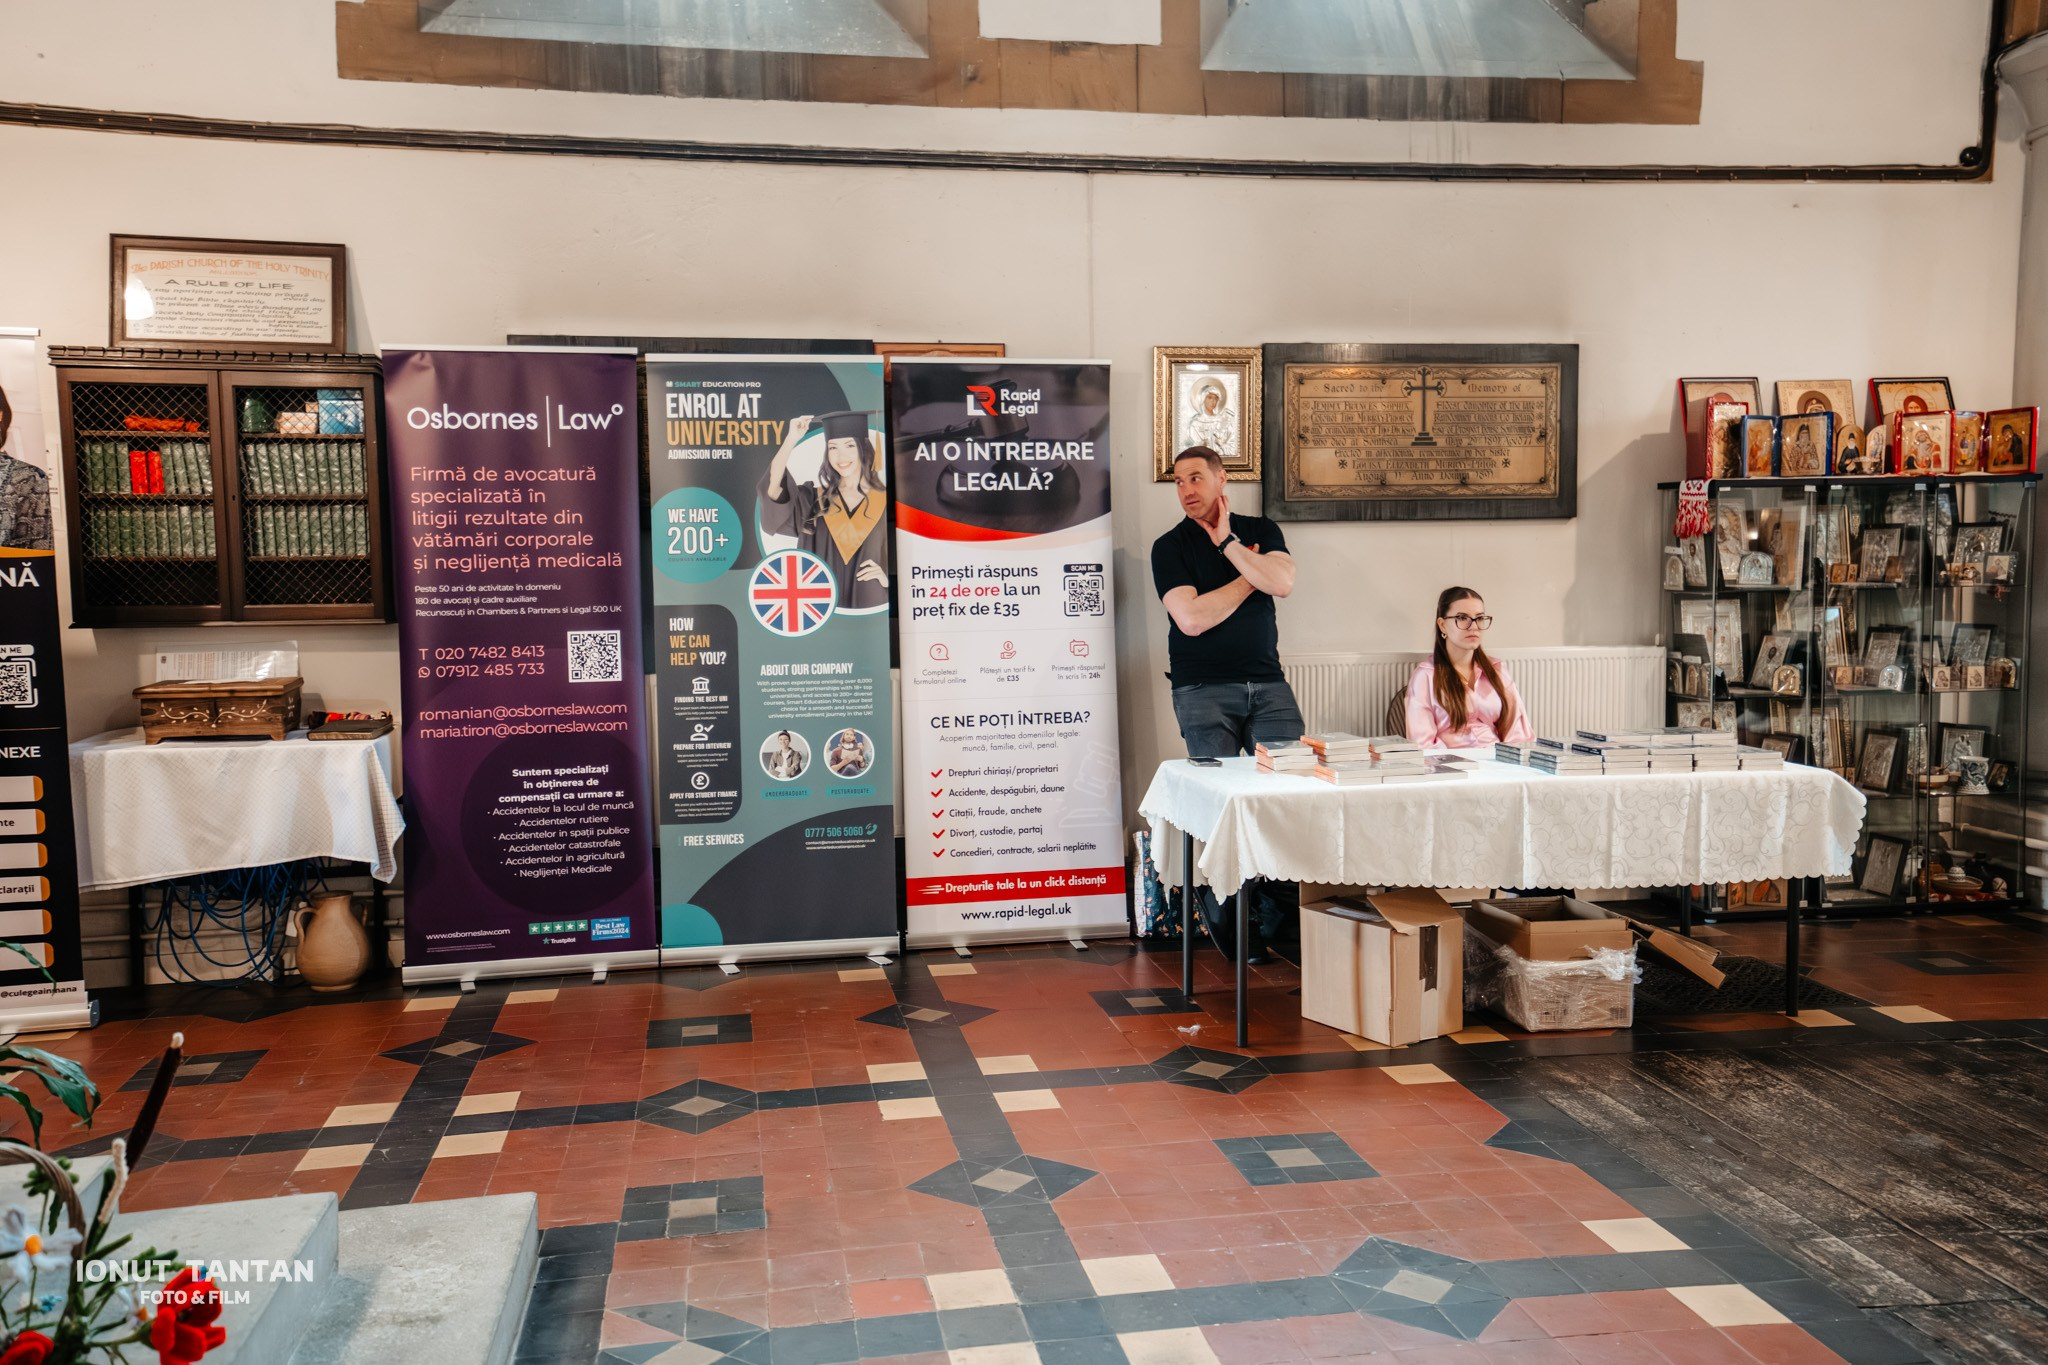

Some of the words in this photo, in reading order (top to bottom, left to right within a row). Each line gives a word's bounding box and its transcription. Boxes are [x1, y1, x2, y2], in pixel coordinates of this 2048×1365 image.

[187, 259, 227, 268] CHURCH
[229, 259, 243, 268] OF
[245, 259, 262, 269] THE
[265, 263, 291, 273] HOLY
[294, 265, 330, 280] TRINITY
[1001, 389, 1040, 403] Rapid
[666, 393, 731, 418] ENROL
[737, 393, 761, 418] AT
[1001, 403, 1038, 417] Legal
[407, 403, 538, 430] Osbornes
[666, 421, 785, 446] UNIVERSITY
[668, 449, 710, 460] ADMISSION
[712, 449, 732, 460] OPEN
[914, 443, 937, 461] AI
[943, 443, 961, 461] O
[966, 438, 1094, 460] ÎNTREBARE
[411, 466, 466, 481] Firmă
[473, 467, 497, 481] de
[504, 466, 596, 481] avocatură
[954, 468, 1053, 491] LEGALĂ?
[411, 488, 522, 507] specializată
[529, 488, 546, 503] în
[412, 511, 457, 529] litigii
[464, 511, 548, 526] rezultate
[554, 510, 583, 524] din
[668, 509, 685, 523] WE
[689, 508, 718, 523] HAVE
[412, 532, 498, 548] vătămări
[504, 532, 594, 550] corporale
[667, 527, 729, 555] 200+
[413, 555, 427, 574] și
[435, 554, 530, 572] neglijență
[537, 552, 622, 568] medicală
[912, 565, 974, 582] Primești
[978, 566, 1038, 580] răspuns
[414, 585, 437, 593] Peste
[466, 584, 476, 592] de
[478, 584, 514, 592] activitate
[525, 583, 561, 591] domeniu
[911, 585, 926, 598] în
[929, 586, 947, 600] 24
[951, 584, 971, 596] de
[975, 587, 1000, 596] ore
[1003, 583, 1019, 596] la
[1022, 586, 1040, 595] un
[912, 603, 944, 621] preț
[949, 603, 965, 616] fix
[970, 602, 990, 615] de
[994, 602, 1020, 617] £35
[669, 618, 694, 631] HOW
[670, 636, 686, 648] WE
[689, 635, 710, 647] CAN
[419, 648, 429, 660] T
[435, 648, 464, 660] 020
[469, 646, 507, 659] 7482
[511, 645, 545, 658] 8413
[670, 652, 697, 666] HELP
[699, 652, 727, 665] YOU?
[436, 665, 479, 678] 07912
[484, 664, 514, 676] 485
[518, 663, 545, 675] 733
[760, 664, 789, 676] ABOUT
[791, 664, 809, 675] OUR
[811, 663, 853, 674] COMPANY
[419, 702, 627, 721] romanian@osborneslaw.com
[931, 716, 950, 728] CE
[955, 716, 975, 727] NE
[980, 714, 1013, 728] POȚI
[1018, 710, 1090, 726] ÎNTREBA?
[420, 720, 628, 739] maria.tiron@osborneslaw.com
[512, 768, 552, 777] Suntem
[554, 765, 609, 776] specializați
[949, 768, 981, 778] Drepturi
[536, 779, 584, 789] obținerea
[586, 778, 599, 786] de
[949, 788, 988, 797] Accidente,
[1041, 784, 1065, 793] daune
[499, 792, 560, 803] compensații
[563, 792, 575, 800] ca
[577, 791, 613, 799] urmare
[615, 790, 624, 798] a:
[493, 805, 550, 815] Accidentelor
[553, 805, 561, 813] la
[564, 804, 585, 812] locul
[588, 803, 600, 811] de
[602, 802, 634, 810] muncă
[978, 806, 1008, 816] fraude,
[1010, 806, 1042, 814] anchete
[519, 816, 576, 827] Accidentelor
[580, 815, 609, 824] rutiere
[805, 828, 825, 838] 0777
[979, 827, 1015, 836] custodie,
[1018, 825, 1043, 835] partaj
[684, 836, 704, 846] FREE
[706, 834, 744, 845] SERVICES
[950, 847, 995, 857] Concedieri,
[997, 846, 1034, 855] contracte,
[1037, 844, 1061, 852] salarii
[1063, 842, 1096, 853] neplătite
[519, 867, 569, 878] Neglijenței
[571, 865, 612, 874] Medicale
[945, 880, 993, 894] Drepturile
[996, 879, 1014, 890] tale
[1017, 877, 1027, 889] la
[1029, 879, 1042, 888] un
[1044, 876, 1065, 887] click
[1068, 874, 1106, 888] distanță
[961, 903, 1071, 920] www.rapid-legal.uk
[426, 928, 511, 941] www.osborneslaw.com
